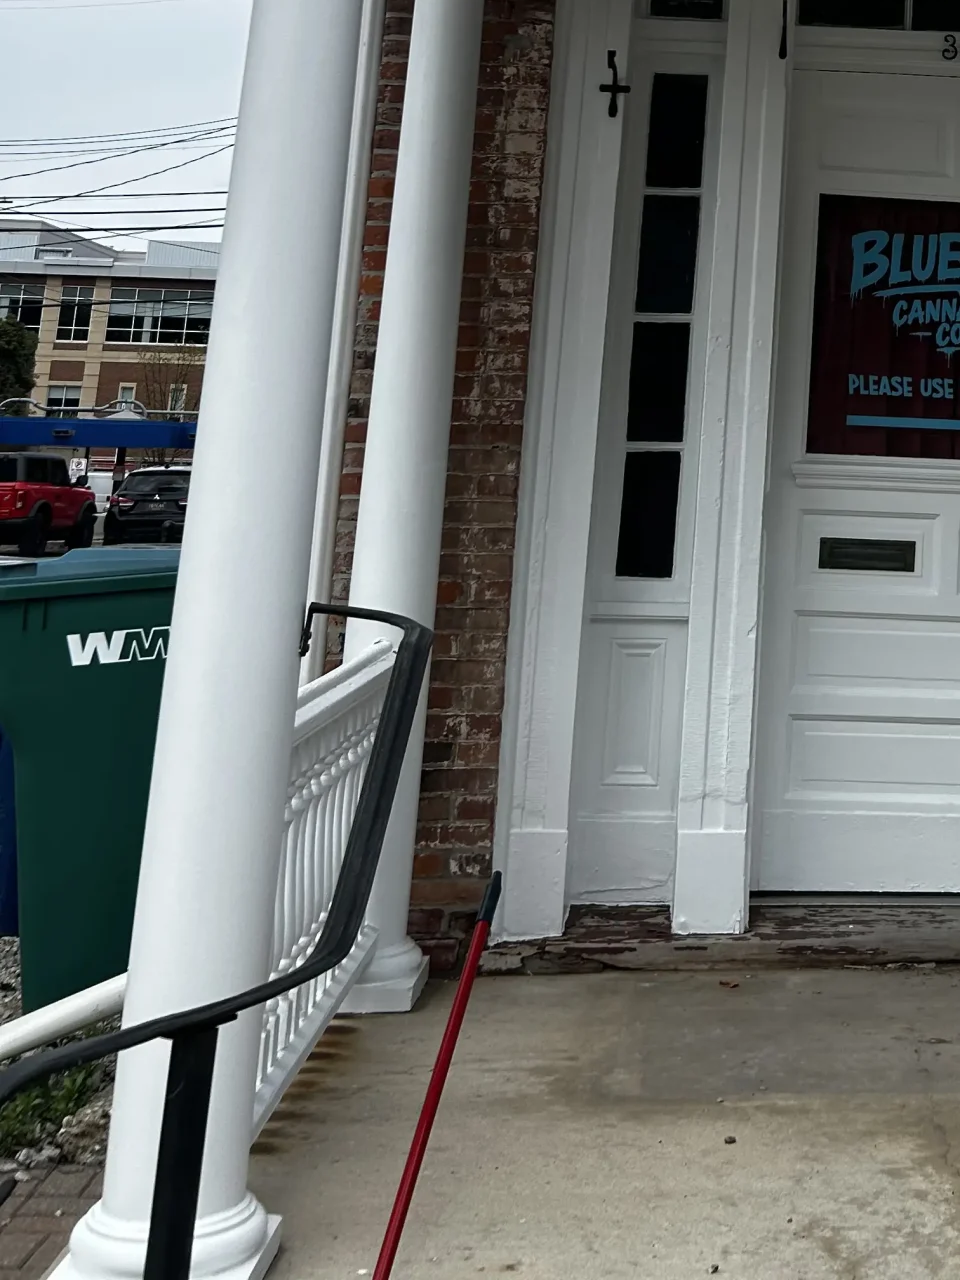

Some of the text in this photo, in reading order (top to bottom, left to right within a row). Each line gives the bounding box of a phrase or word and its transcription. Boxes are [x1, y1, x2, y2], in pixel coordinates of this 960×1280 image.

[848, 373, 913, 398] PLEASE
[919, 378, 954, 400] USE
[66, 625, 171, 667] WM
